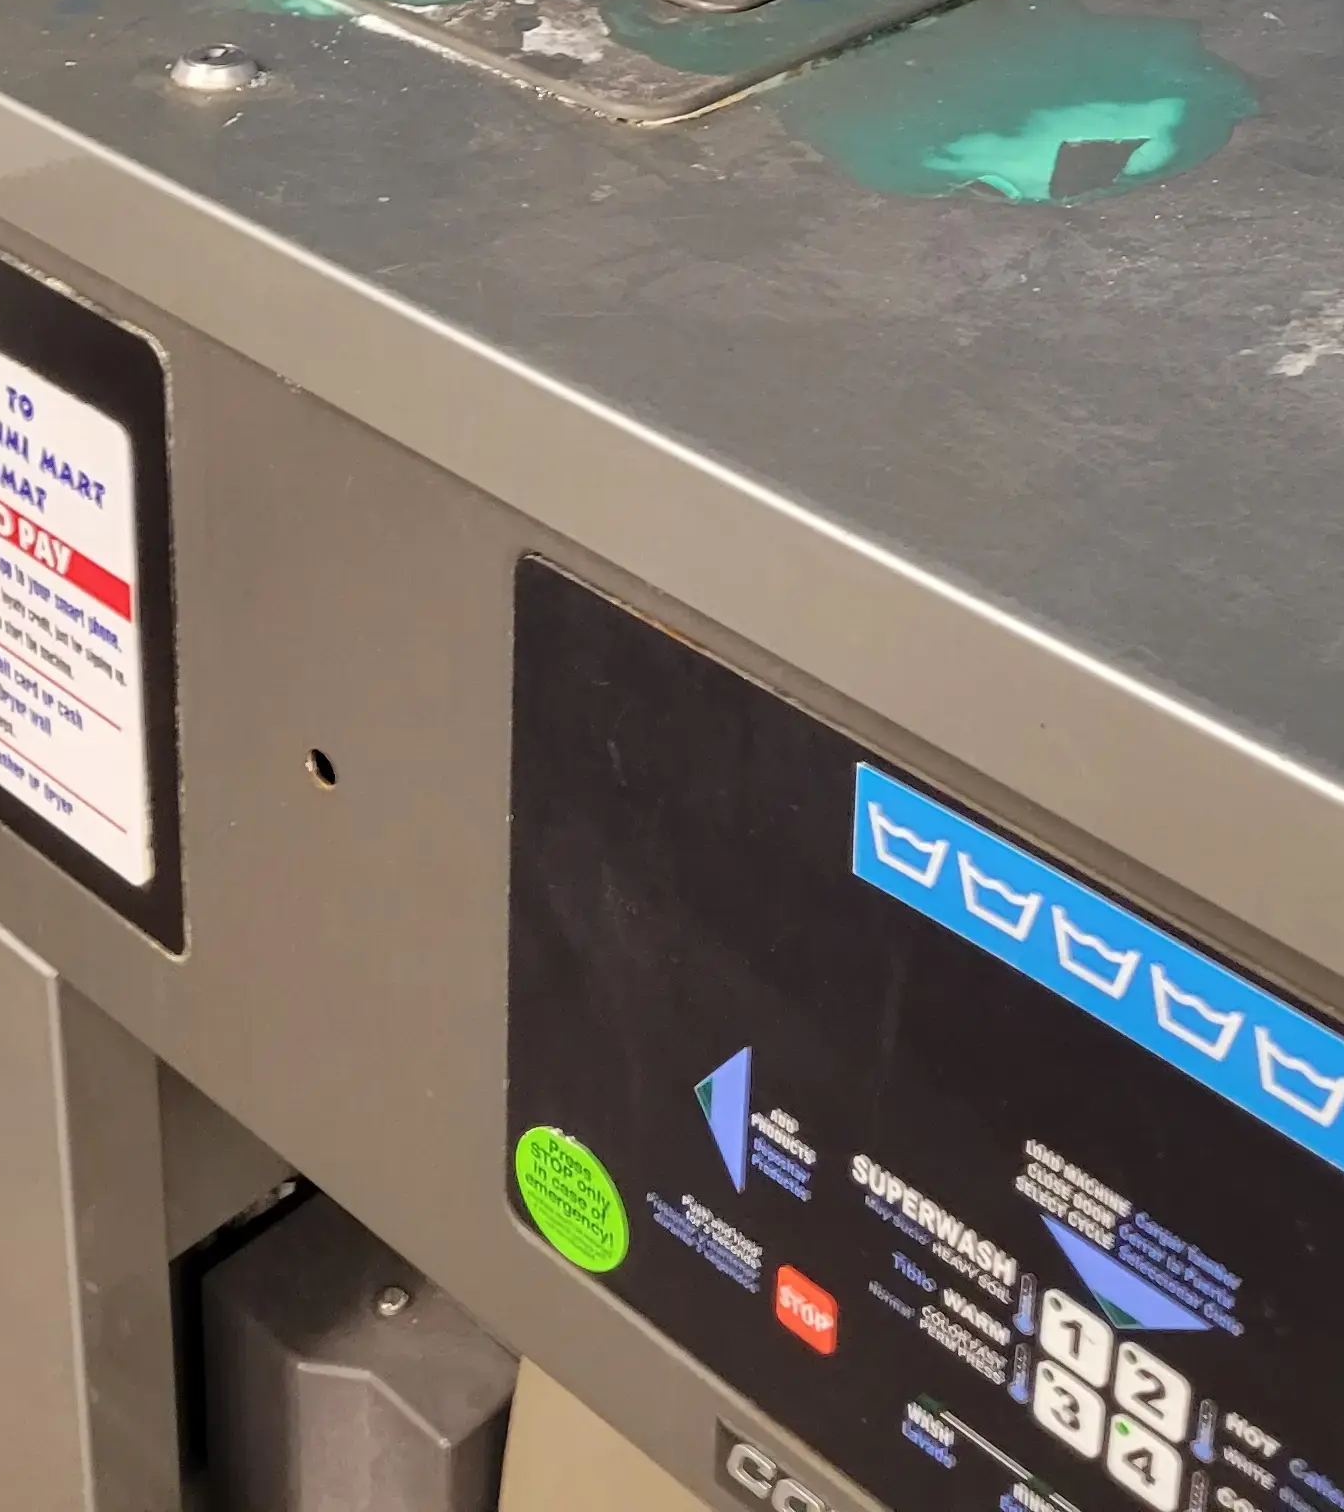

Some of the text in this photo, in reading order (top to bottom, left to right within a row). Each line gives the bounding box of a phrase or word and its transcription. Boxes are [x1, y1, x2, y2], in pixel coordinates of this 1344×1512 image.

[6, 386, 34, 421] TO
[39, 447, 106, 510] MART
[17, 516, 73, 576] PAY
[751, 1112, 817, 1165] PRODUCTS
[771, 1108, 799, 1134] ADD
[530, 1141, 610, 1214] STOP only
[549, 1138, 592, 1182] Press
[1025, 1138, 1133, 1218] LOAD MACHINE
[552, 1177, 587, 1210] case
[591, 1206, 607, 1226] of
[852, 1154, 1017, 1287] SUPERWASH
[1015, 1174, 1116, 1251] SELECT CYCLE
[1027, 1161, 1116, 1229] CLOSE DOOR
[892, 1249, 1011, 1347] Tibio WARM
[931, 1241, 980, 1279] HEAVY
[977, 1273, 1014, 1305] SOIL
[779, 1285, 834, 1333] STOP
[920, 1317, 1006, 1386] PERM PRESS
[1059, 1319, 1168, 1422] 1 2
[907, 1401, 955, 1447] WASH
[1051, 1385, 1156, 1488] 3 4
[1225, 1411, 1282, 1458] HOT
[1222, 1444, 1278, 1491] WHITE
